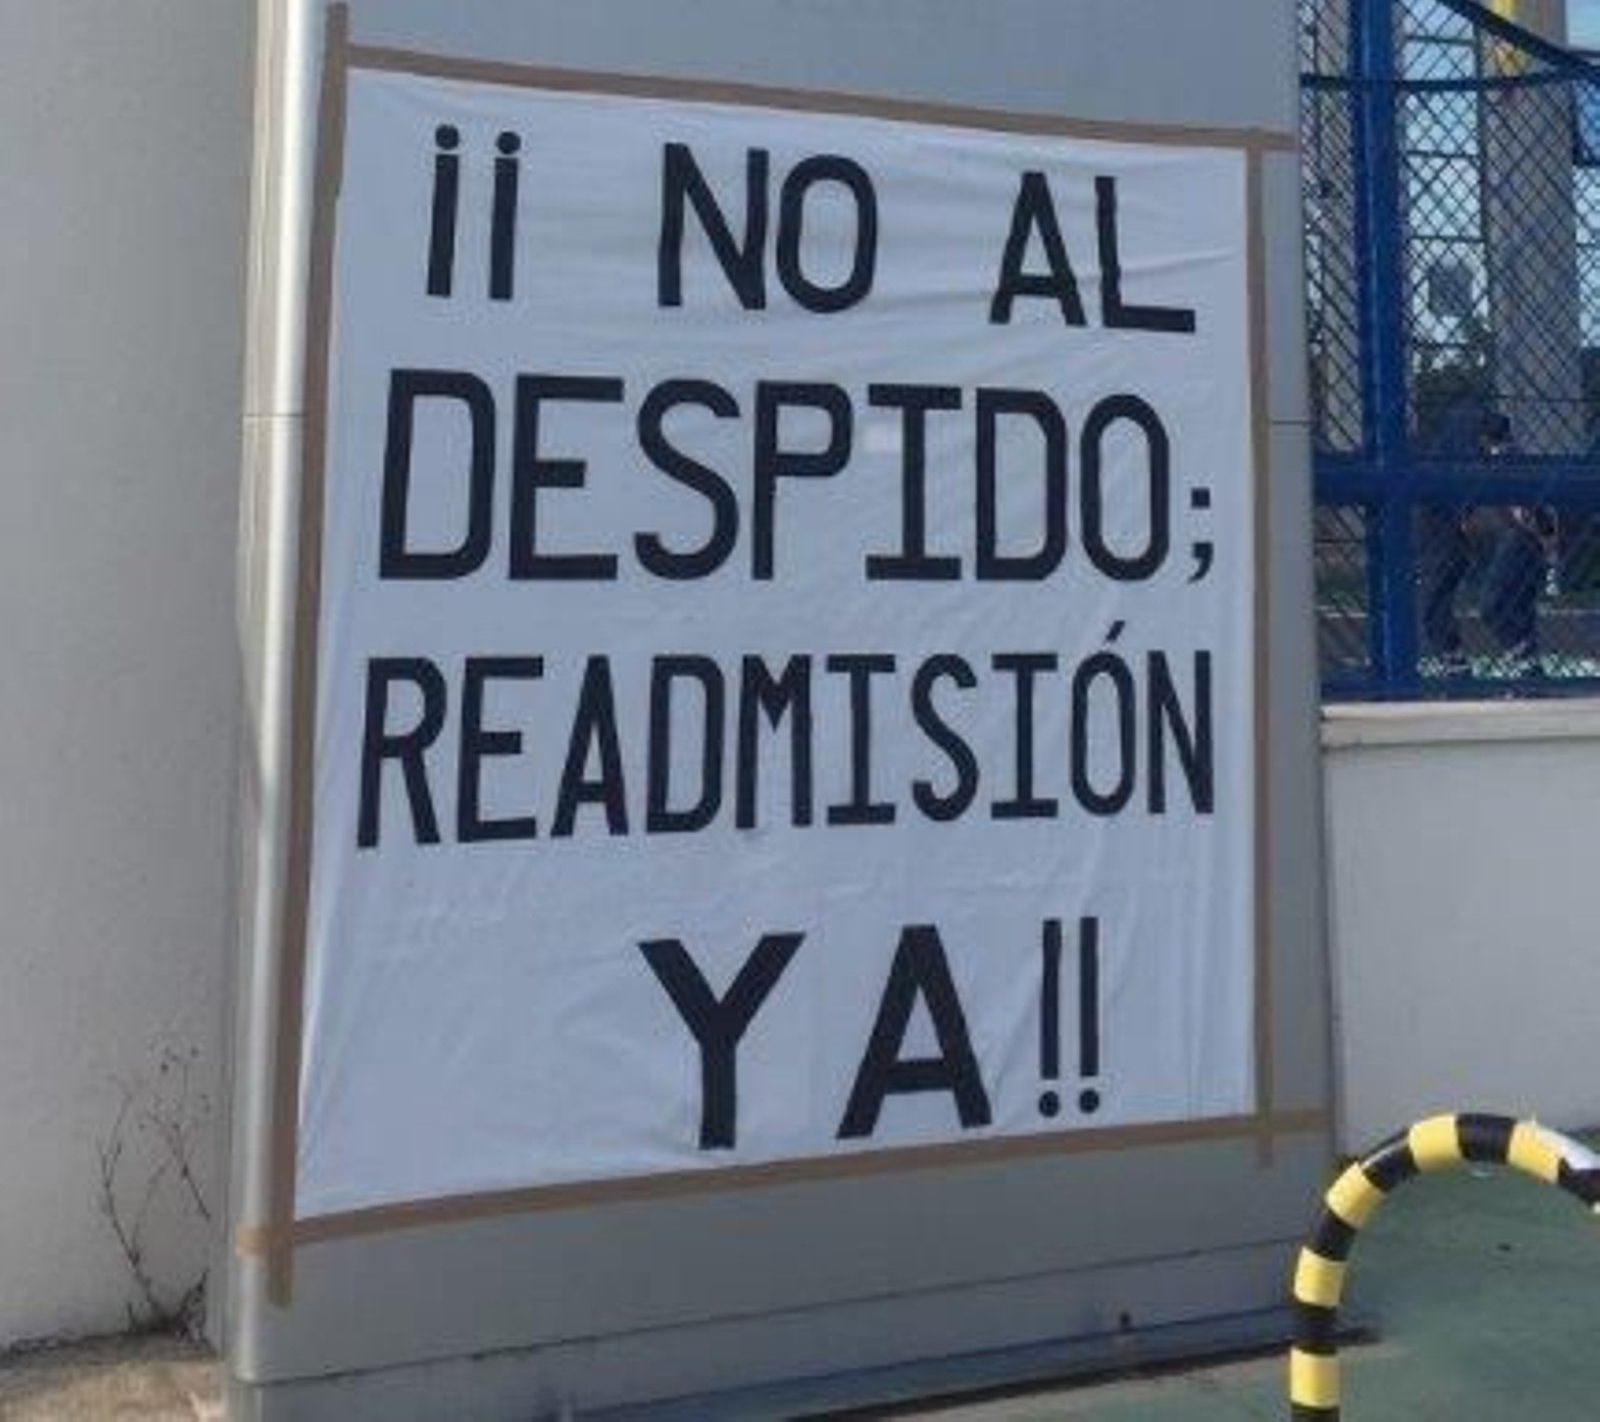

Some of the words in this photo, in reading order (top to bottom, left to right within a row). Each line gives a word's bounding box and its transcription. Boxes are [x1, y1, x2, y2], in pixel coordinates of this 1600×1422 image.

[427, 125, 520, 301] ¡¡
[658, 143, 878, 314] NO
[990, 171, 1195, 333] AL
[379, 369, 1213, 581] DESPIDO;
[357, 621, 1214, 849] READMISIÓN
